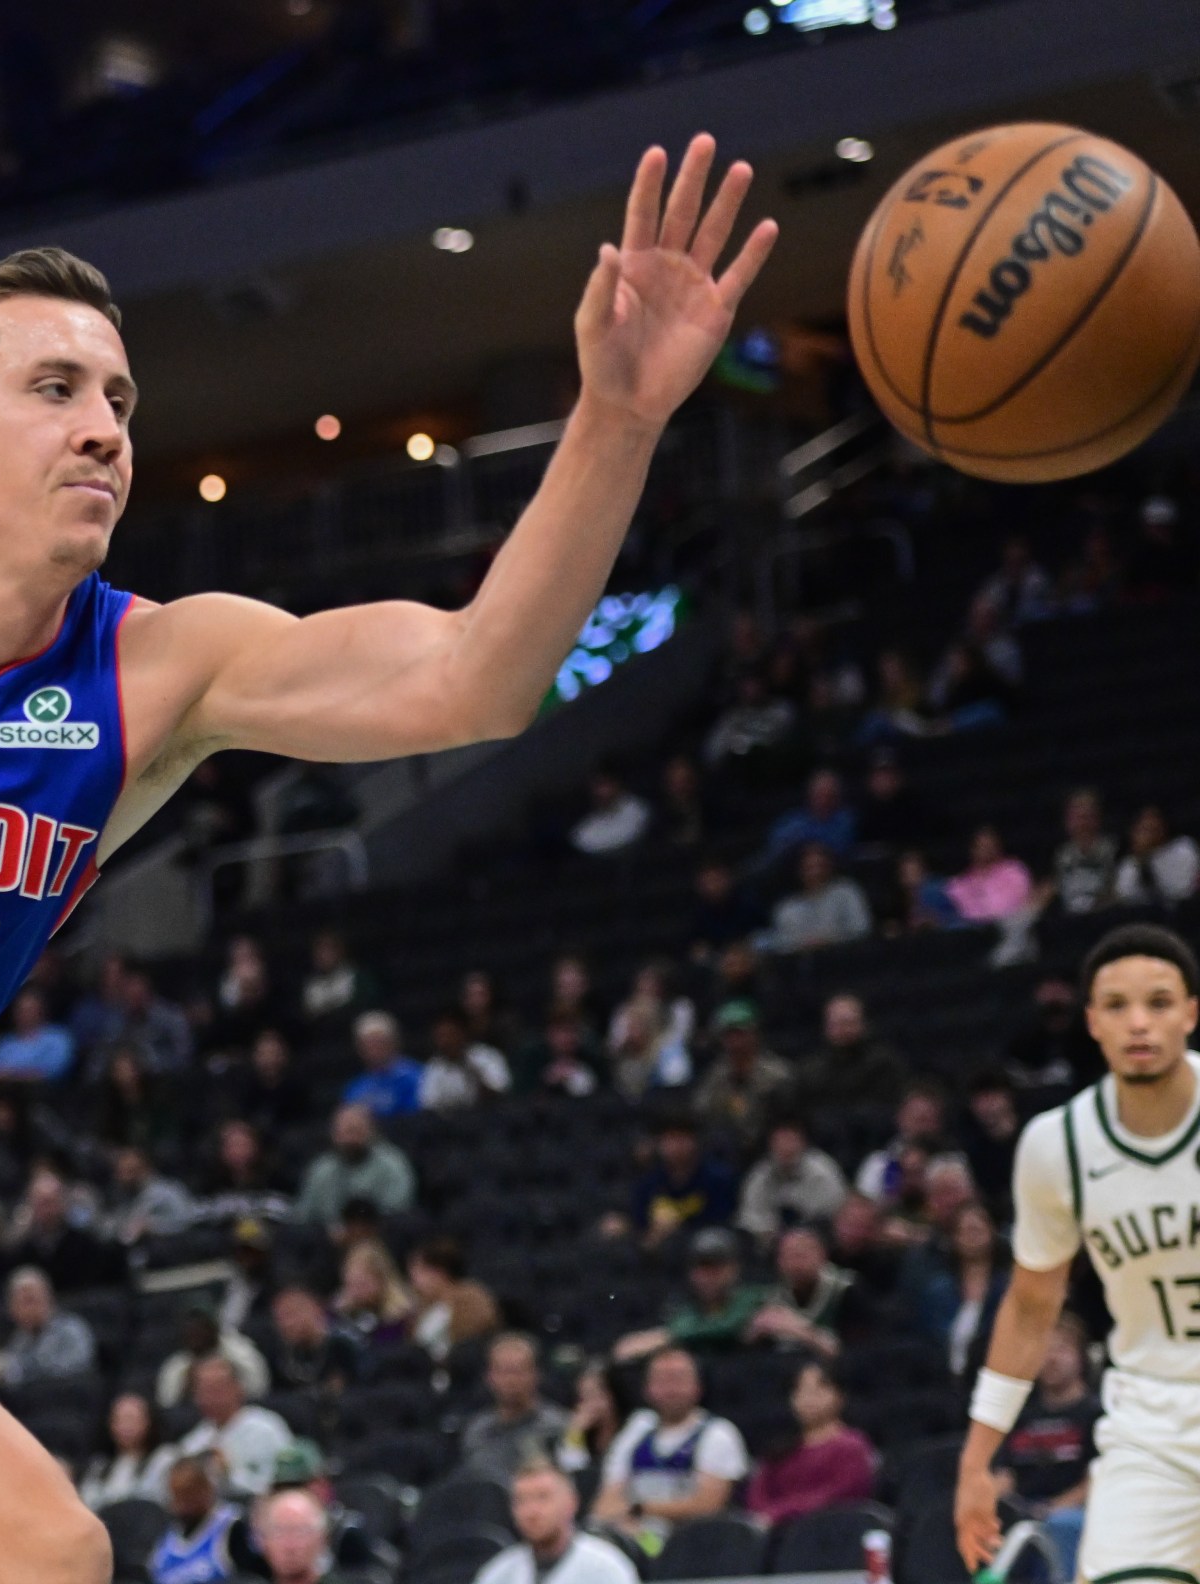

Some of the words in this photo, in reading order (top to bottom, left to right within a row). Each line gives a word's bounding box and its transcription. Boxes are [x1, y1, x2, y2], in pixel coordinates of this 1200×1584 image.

[960, 155, 1135, 340] Wilson
[0, 725, 95, 745] StockX
[1150, 1274, 1200, 1340] 13
